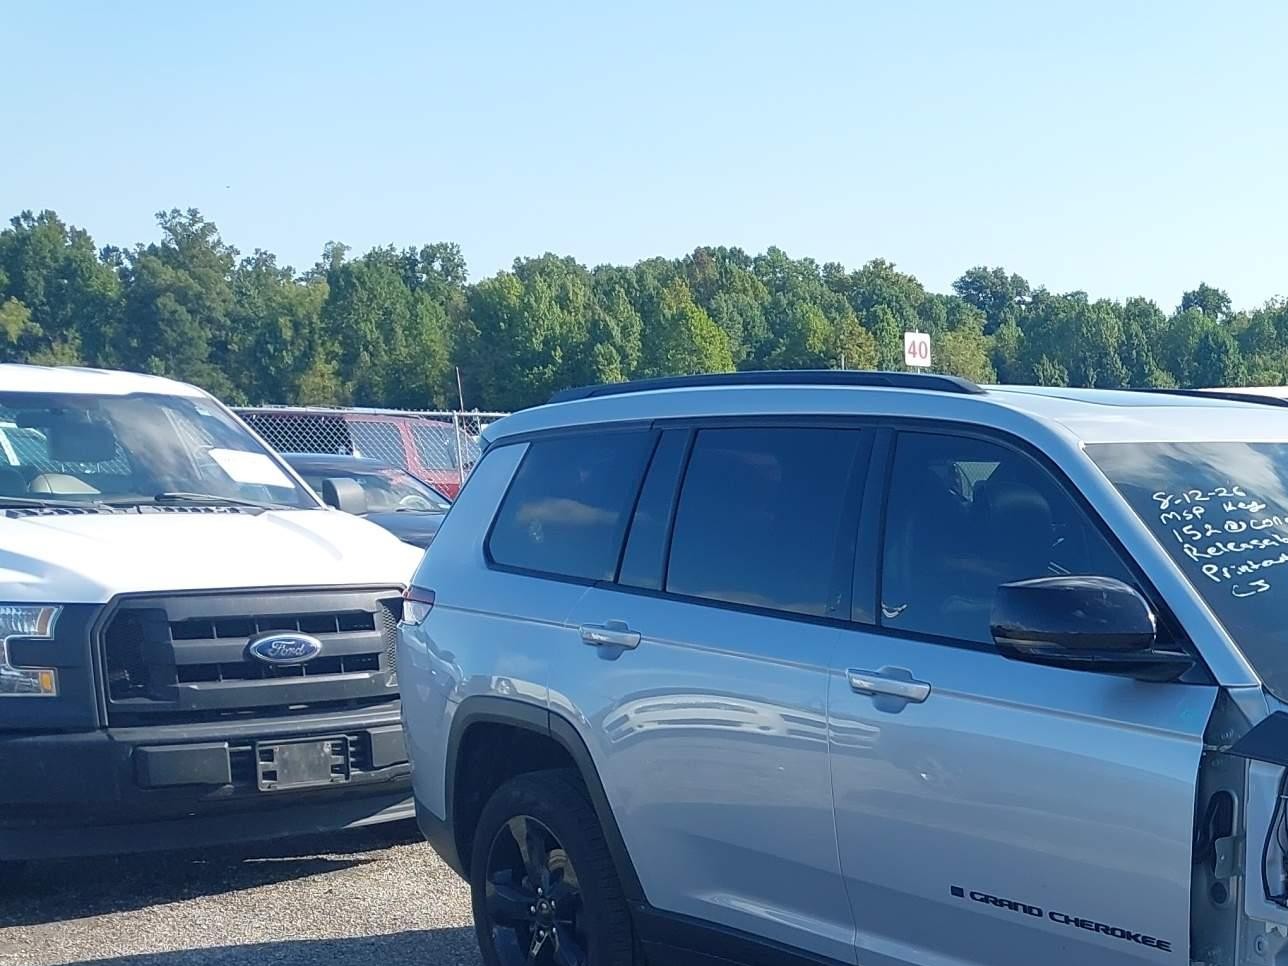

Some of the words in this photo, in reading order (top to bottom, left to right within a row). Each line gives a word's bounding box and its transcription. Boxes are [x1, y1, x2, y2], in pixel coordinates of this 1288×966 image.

[908, 340, 928, 359] 40
[268, 640, 305, 656] Ford
[969, 891, 1043, 917] GRAND
[1049, 911, 1172, 952] CHEROKEE
